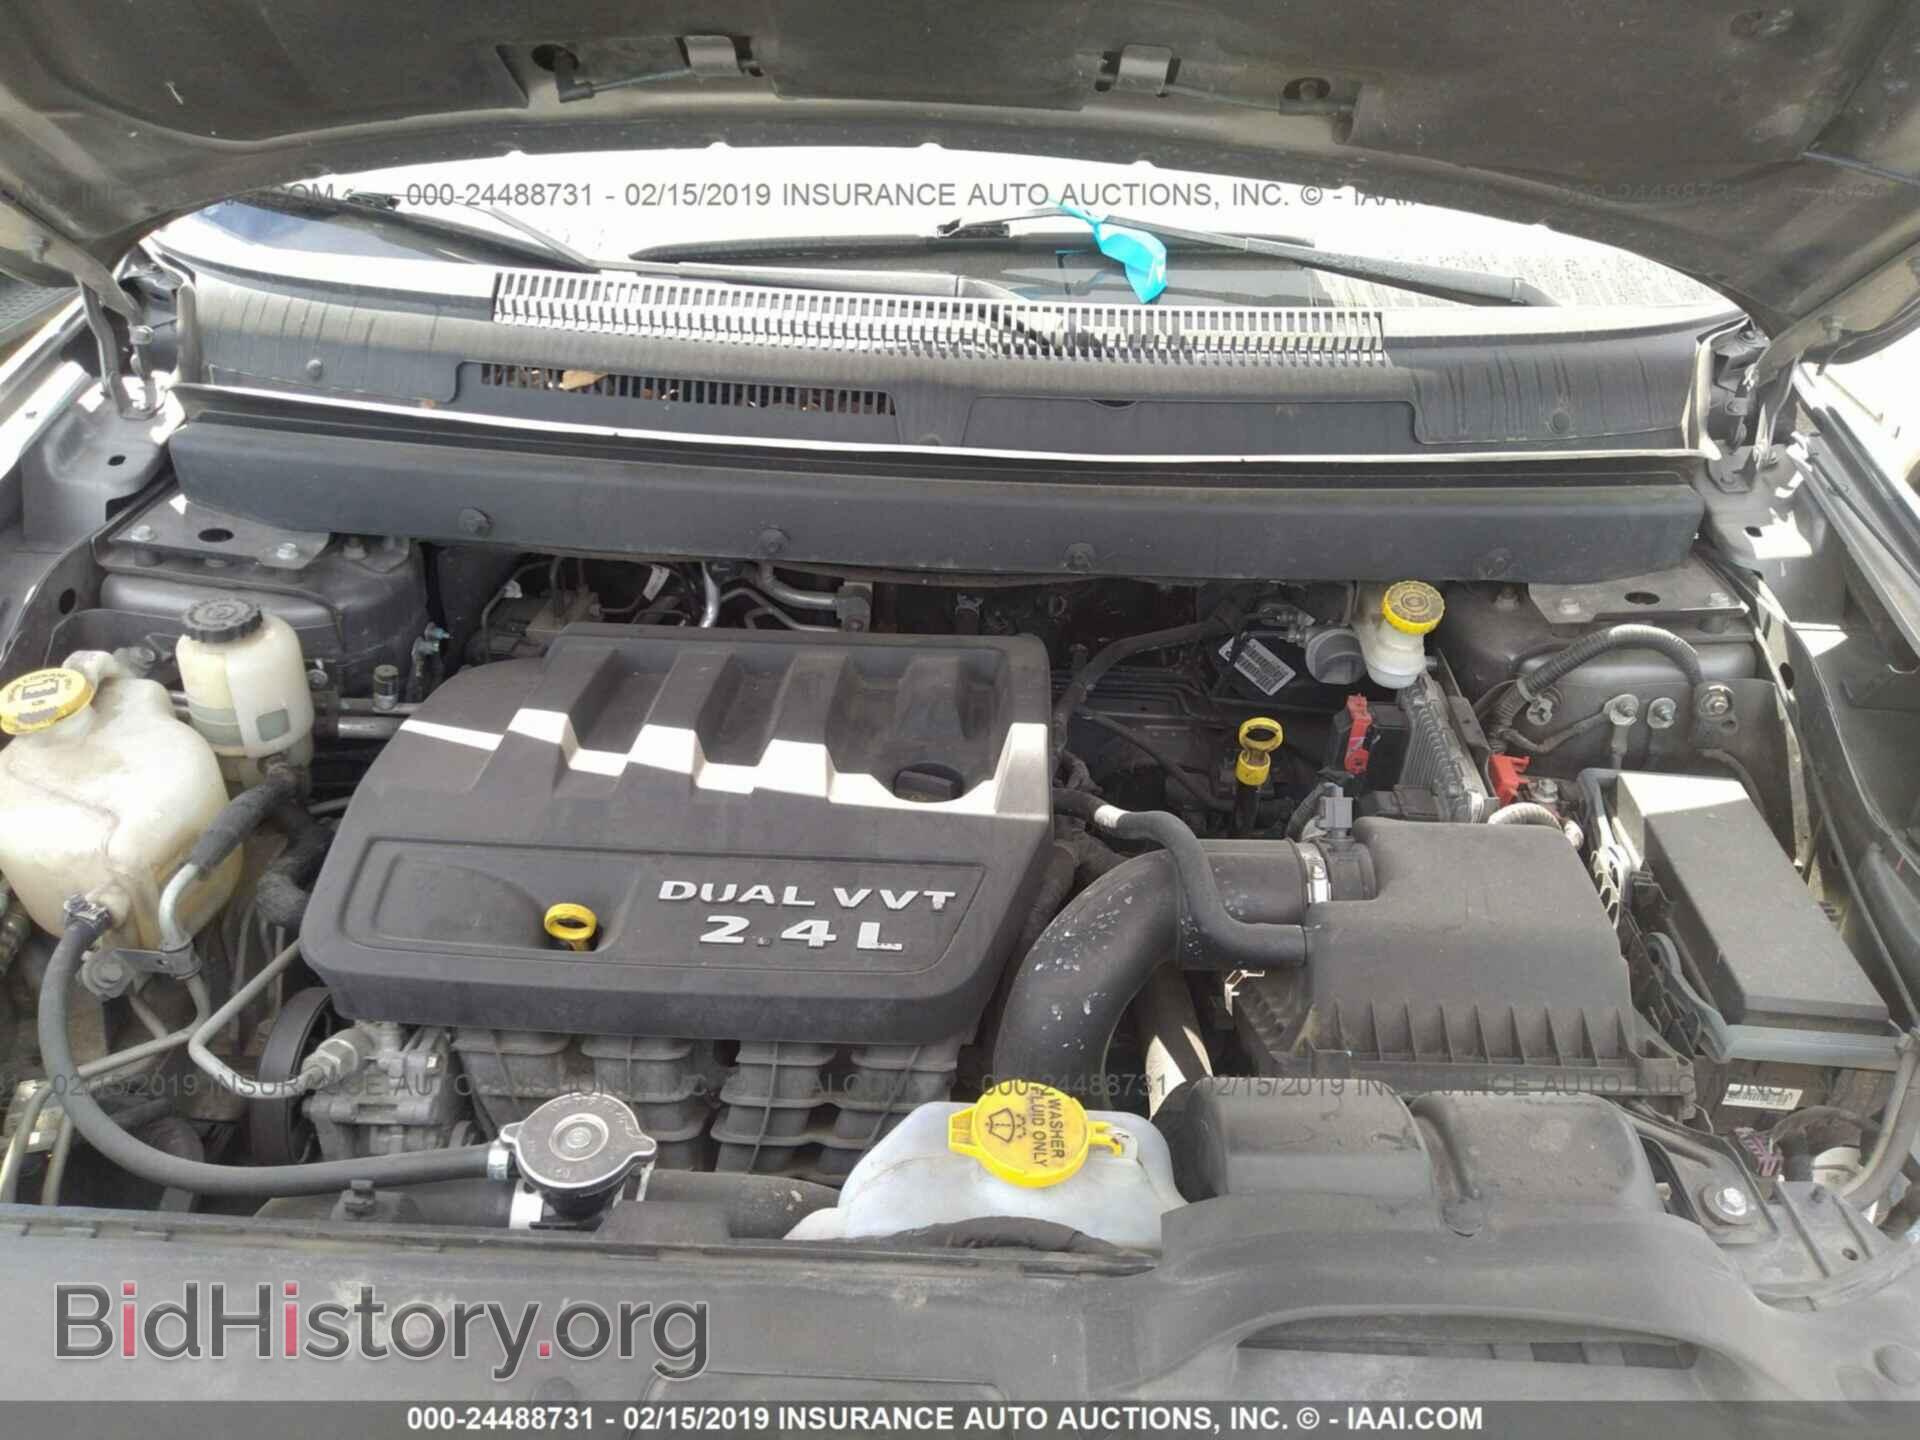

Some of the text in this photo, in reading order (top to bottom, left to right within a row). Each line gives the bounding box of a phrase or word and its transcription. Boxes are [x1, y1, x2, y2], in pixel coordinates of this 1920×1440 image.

[658, 880, 956, 911] DUAL VVT
[1030, 1086, 1048, 1168] FLUID ONLY
[1048, 1098, 1065, 1159] WASHER
